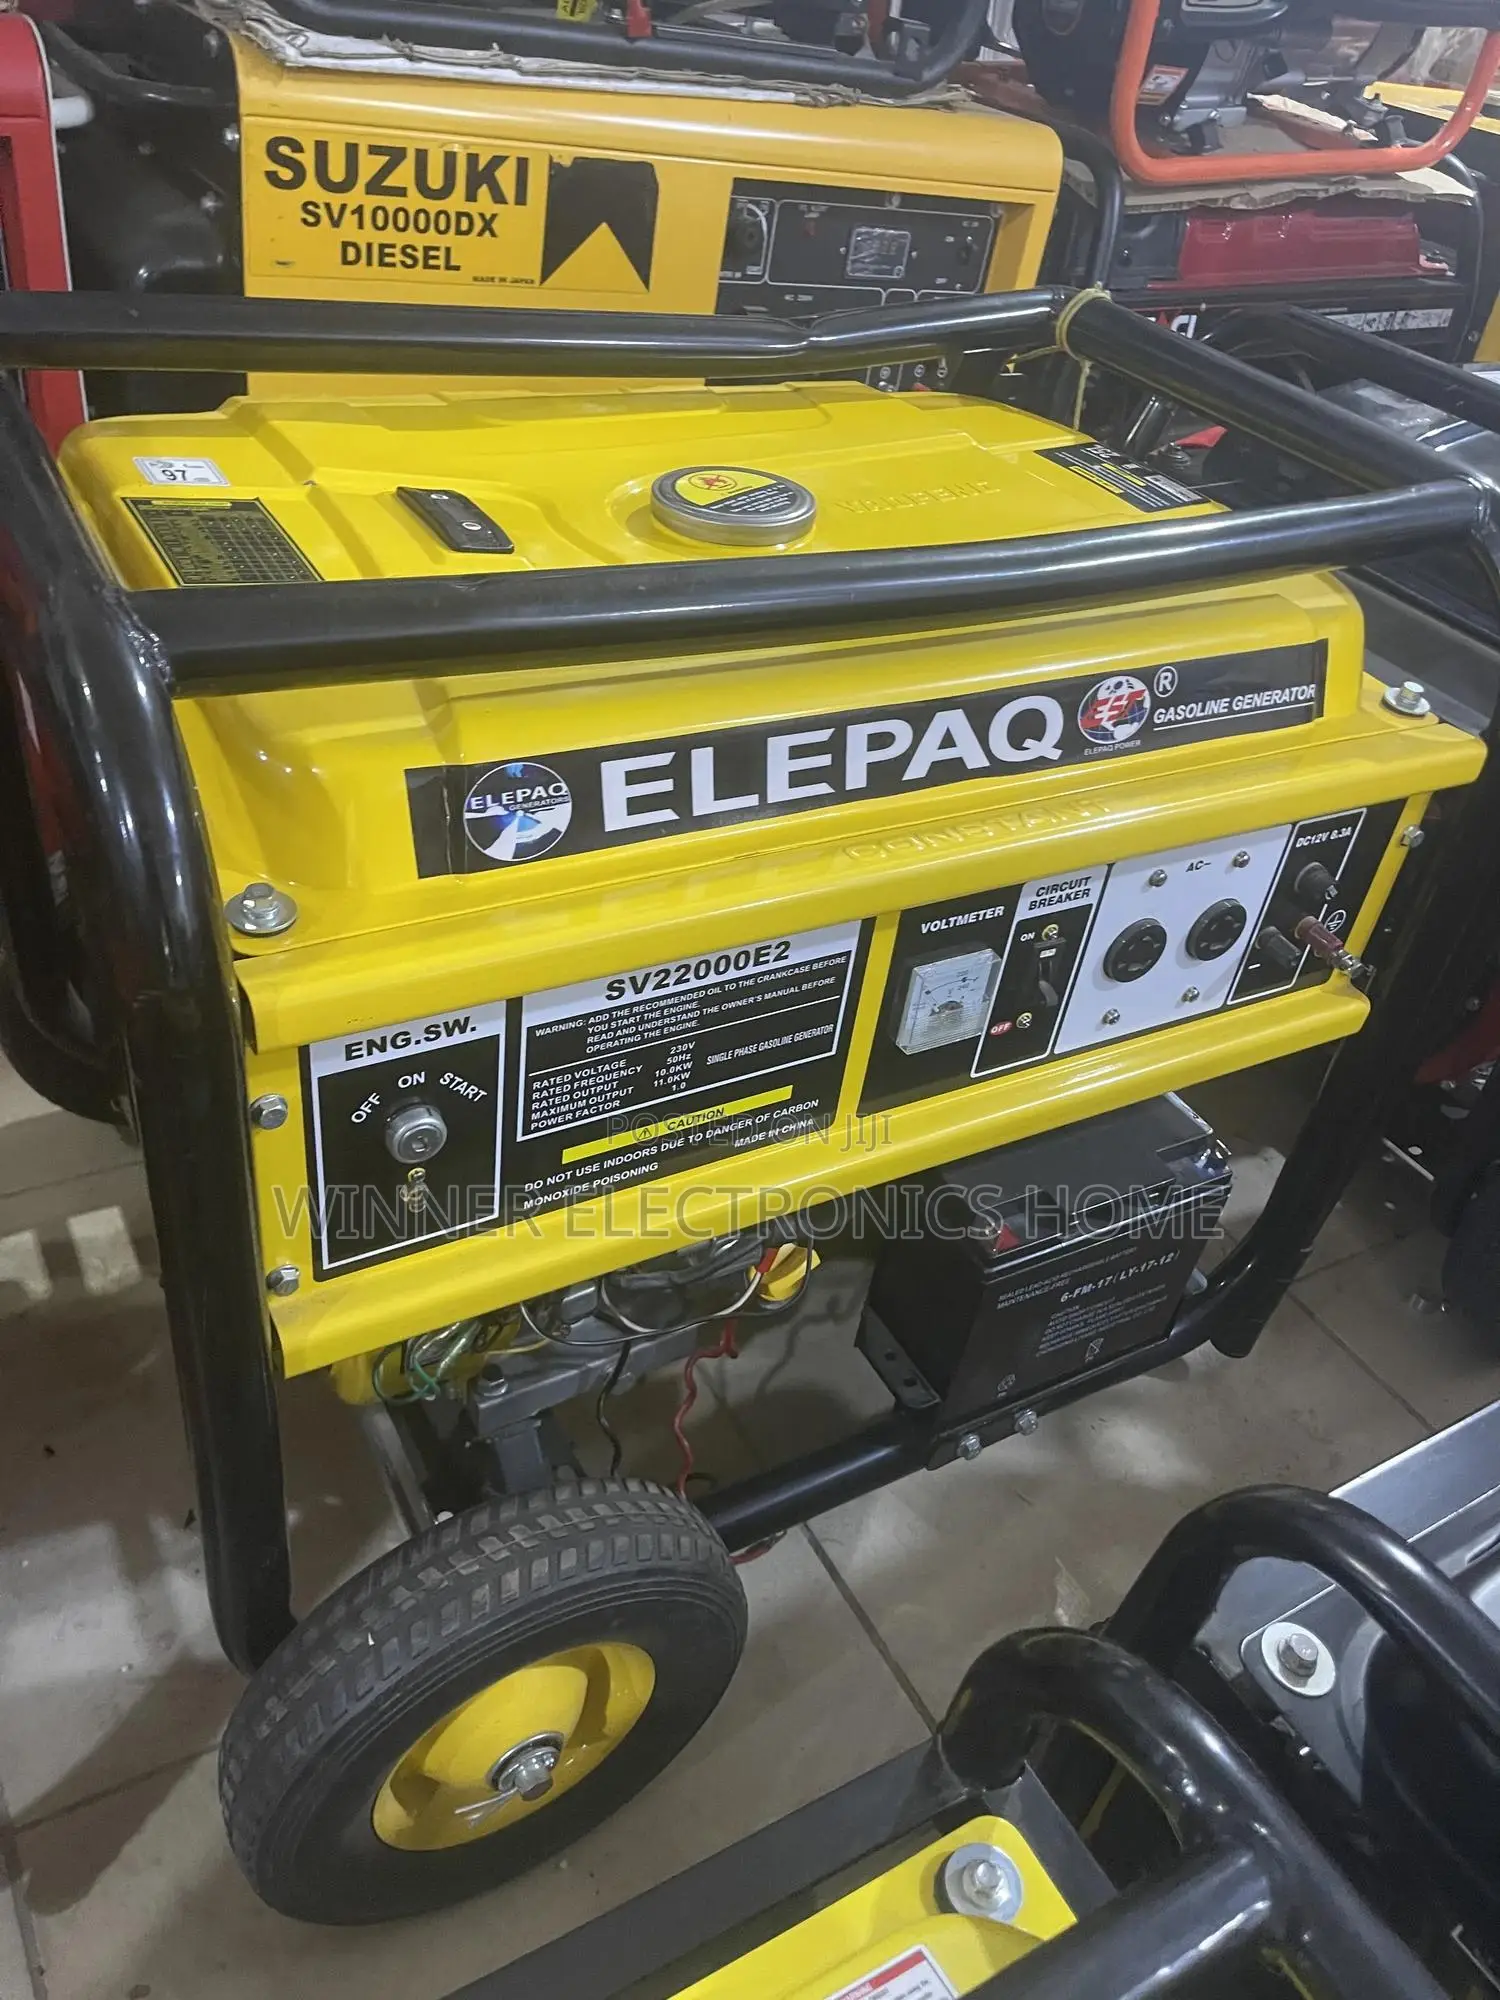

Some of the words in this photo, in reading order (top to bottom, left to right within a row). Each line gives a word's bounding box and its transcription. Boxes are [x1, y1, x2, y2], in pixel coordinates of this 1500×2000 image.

[264, 136, 529, 206] SUZUKI
[300, 200, 499, 238] SV10000DX
[341, 240, 461, 271] DIESEL
[161, 469, 186, 481] 97
[1153, 698, 1229, 724] GASOLINE
[1232, 684, 1316, 711] GENERATOR
[600, 695, 1064, 832] ELEPAQ
[1083, 744, 1114, 756] ELEPAQ
[1114, 740, 1141, 751] POWER
[470, 783, 568, 810] ELEPAQ
[842, 798, 1110, 860] CONSTANT
[1295, 831, 1330, 848] DC12V
[1330, 826, 1352, 840] 8.3A
[1028, 888, 1091, 911] BREAKER
[1035, 876, 1092, 897] CIRCUIT
[921, 905, 1005, 934] VOLTMETER
[1020, 932, 1035, 942] ON
[604, 940, 792, 1001] SV22000E2
[535, 1019, 586, 1037] WARNING:
[588, 1013, 610, 1025] ADD
[612, 1008, 631, 1019] THE
[632, 989, 705, 1014] RECOMMENDED
[707, 987, 722, 996] OIL
[724, 983, 736, 992] TO
[738, 978, 755, 988] THE
[756, 965, 811, 983] CRANKCASE
[811, 956, 848, 970] BEFORE
[587, 1032, 614, 1044] READ
[615, 1026, 636, 1037] AND
[638, 1010, 701, 1031] UNDERSTAND
[702, 1005, 720, 1015] THE
[721, 993, 763, 1011] OWNER'S
[763, 986, 800, 1000] MANUAL
[801, 976, 837, 990] BEFORE
[588, 1024, 609, 1034] YOU
[610, 1016, 642, 1029] START
[643, 1010, 662, 1021] THE
[663, 1001, 701, 1016] ENGINE.
[990, 1022, 1013, 1034] OFF
[344, 1016, 477, 1062] ENG.SW.
[586, 1034, 642, 1054] OPERATING
[643, 1029, 662, 1039] THE
[663, 1019, 701, 1034] ENGINE.
[706, 1051, 733, 1065] SINGLE
[733, 1044, 758, 1058] PHASE
[758, 1034, 793, 1052] GASOLINE
[793, 1023, 834, 1042] GENERATOR
[397, 1071, 426, 1088] ON
[532, 1073, 572, 1090] RATED
[574, 1059, 627, 1079] VOLTAGE
[669, 1041, 696, 1055] 230V
[532, 1083, 571, 1100] RATED
[573, 1065, 643, 1090] FREQUENCY
[666, 1053, 692, 1065] 50Hz
[439, 1072, 488, 1102] START
[531, 1094, 570, 1111] RATED
[572, 1081, 619, 1099] OUTPUT
[654, 1061, 693, 1078] 10.0KW
[531, 1100, 586, 1120] MAXIMUM
[588, 1086, 635, 1105] OUTPUT
[653, 1071, 691, 1088] 11.0KW
[351, 1092, 381, 1123] OFF
[530, 1113, 573, 1131] POWER
[575, 1100, 621, 1119] FACTOR
[671, 1081, 686, 1092] 1.0
[667, 1107, 725, 1131] CAUTION
[524, 1180, 544, 1192] DO
[546, 1170, 573, 1186] NOT
[575, 1162, 601, 1177] USE
[603, 1145, 658, 1169] INDOORS
[661, 1139, 685, 1152] DUE
[688, 1133, 703, 1144] TO
[705, 1119, 753, 1139] DANGER
[755, 1114, 770, 1124] OF
[773, 1099, 820, 1118] CARBON
[734, 1133, 766, 1148] MADE
[768, 1129, 779, 1138] IN
[778, 1118, 814, 1134] CHINA
[523, 1182, 589, 1210] MONOXIDE
[592, 1162, 659, 1188] POISONING
